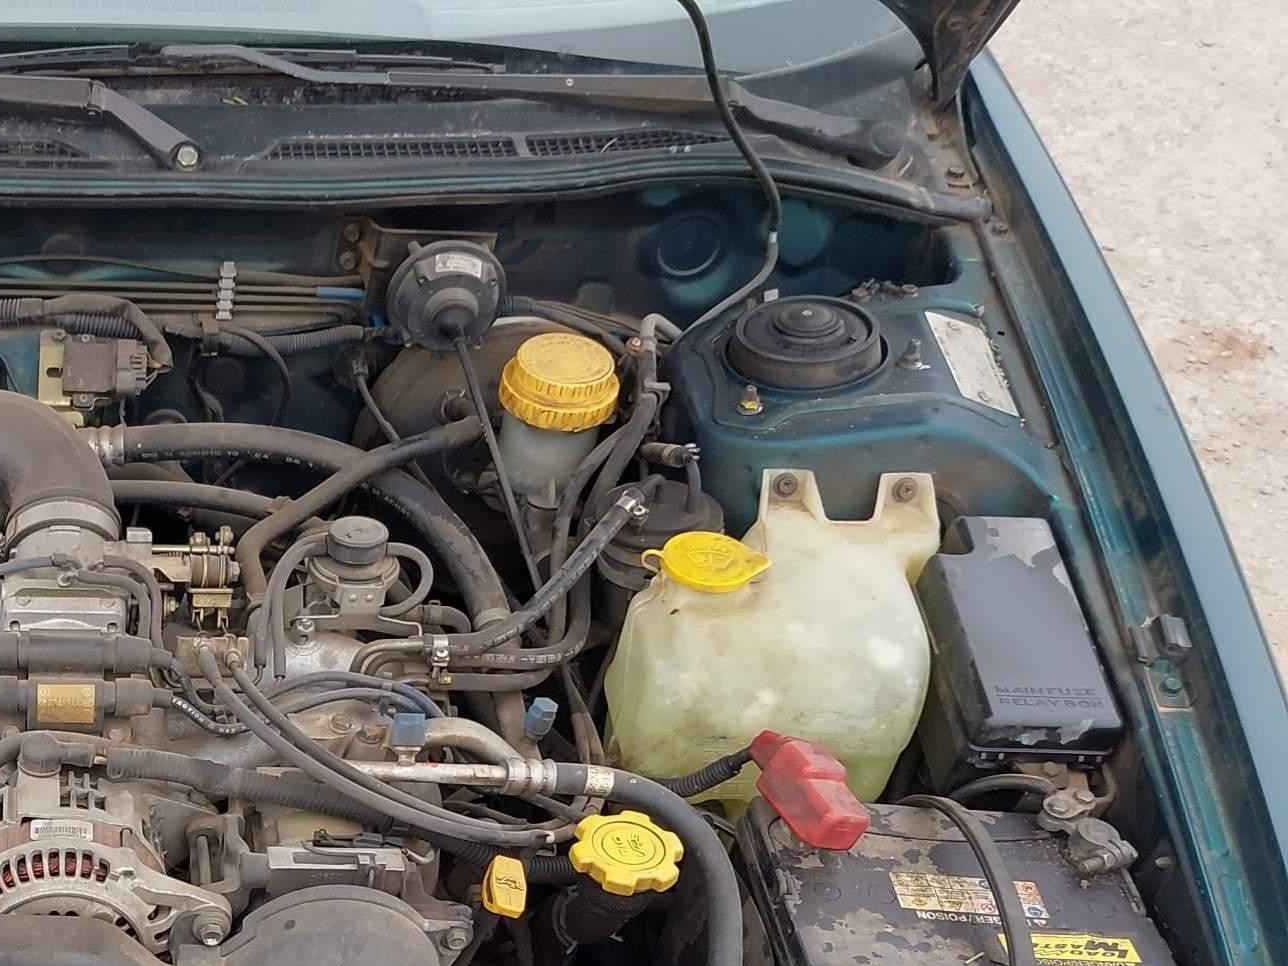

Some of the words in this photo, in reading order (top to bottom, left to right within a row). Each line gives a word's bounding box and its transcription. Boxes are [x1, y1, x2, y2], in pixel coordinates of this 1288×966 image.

[995, 685, 1042, 695] MAIN
[1046, 687, 1097, 697] FUSE
[999, 697, 1059, 707] RELAY
[1063, 699, 1105, 709] BOX
